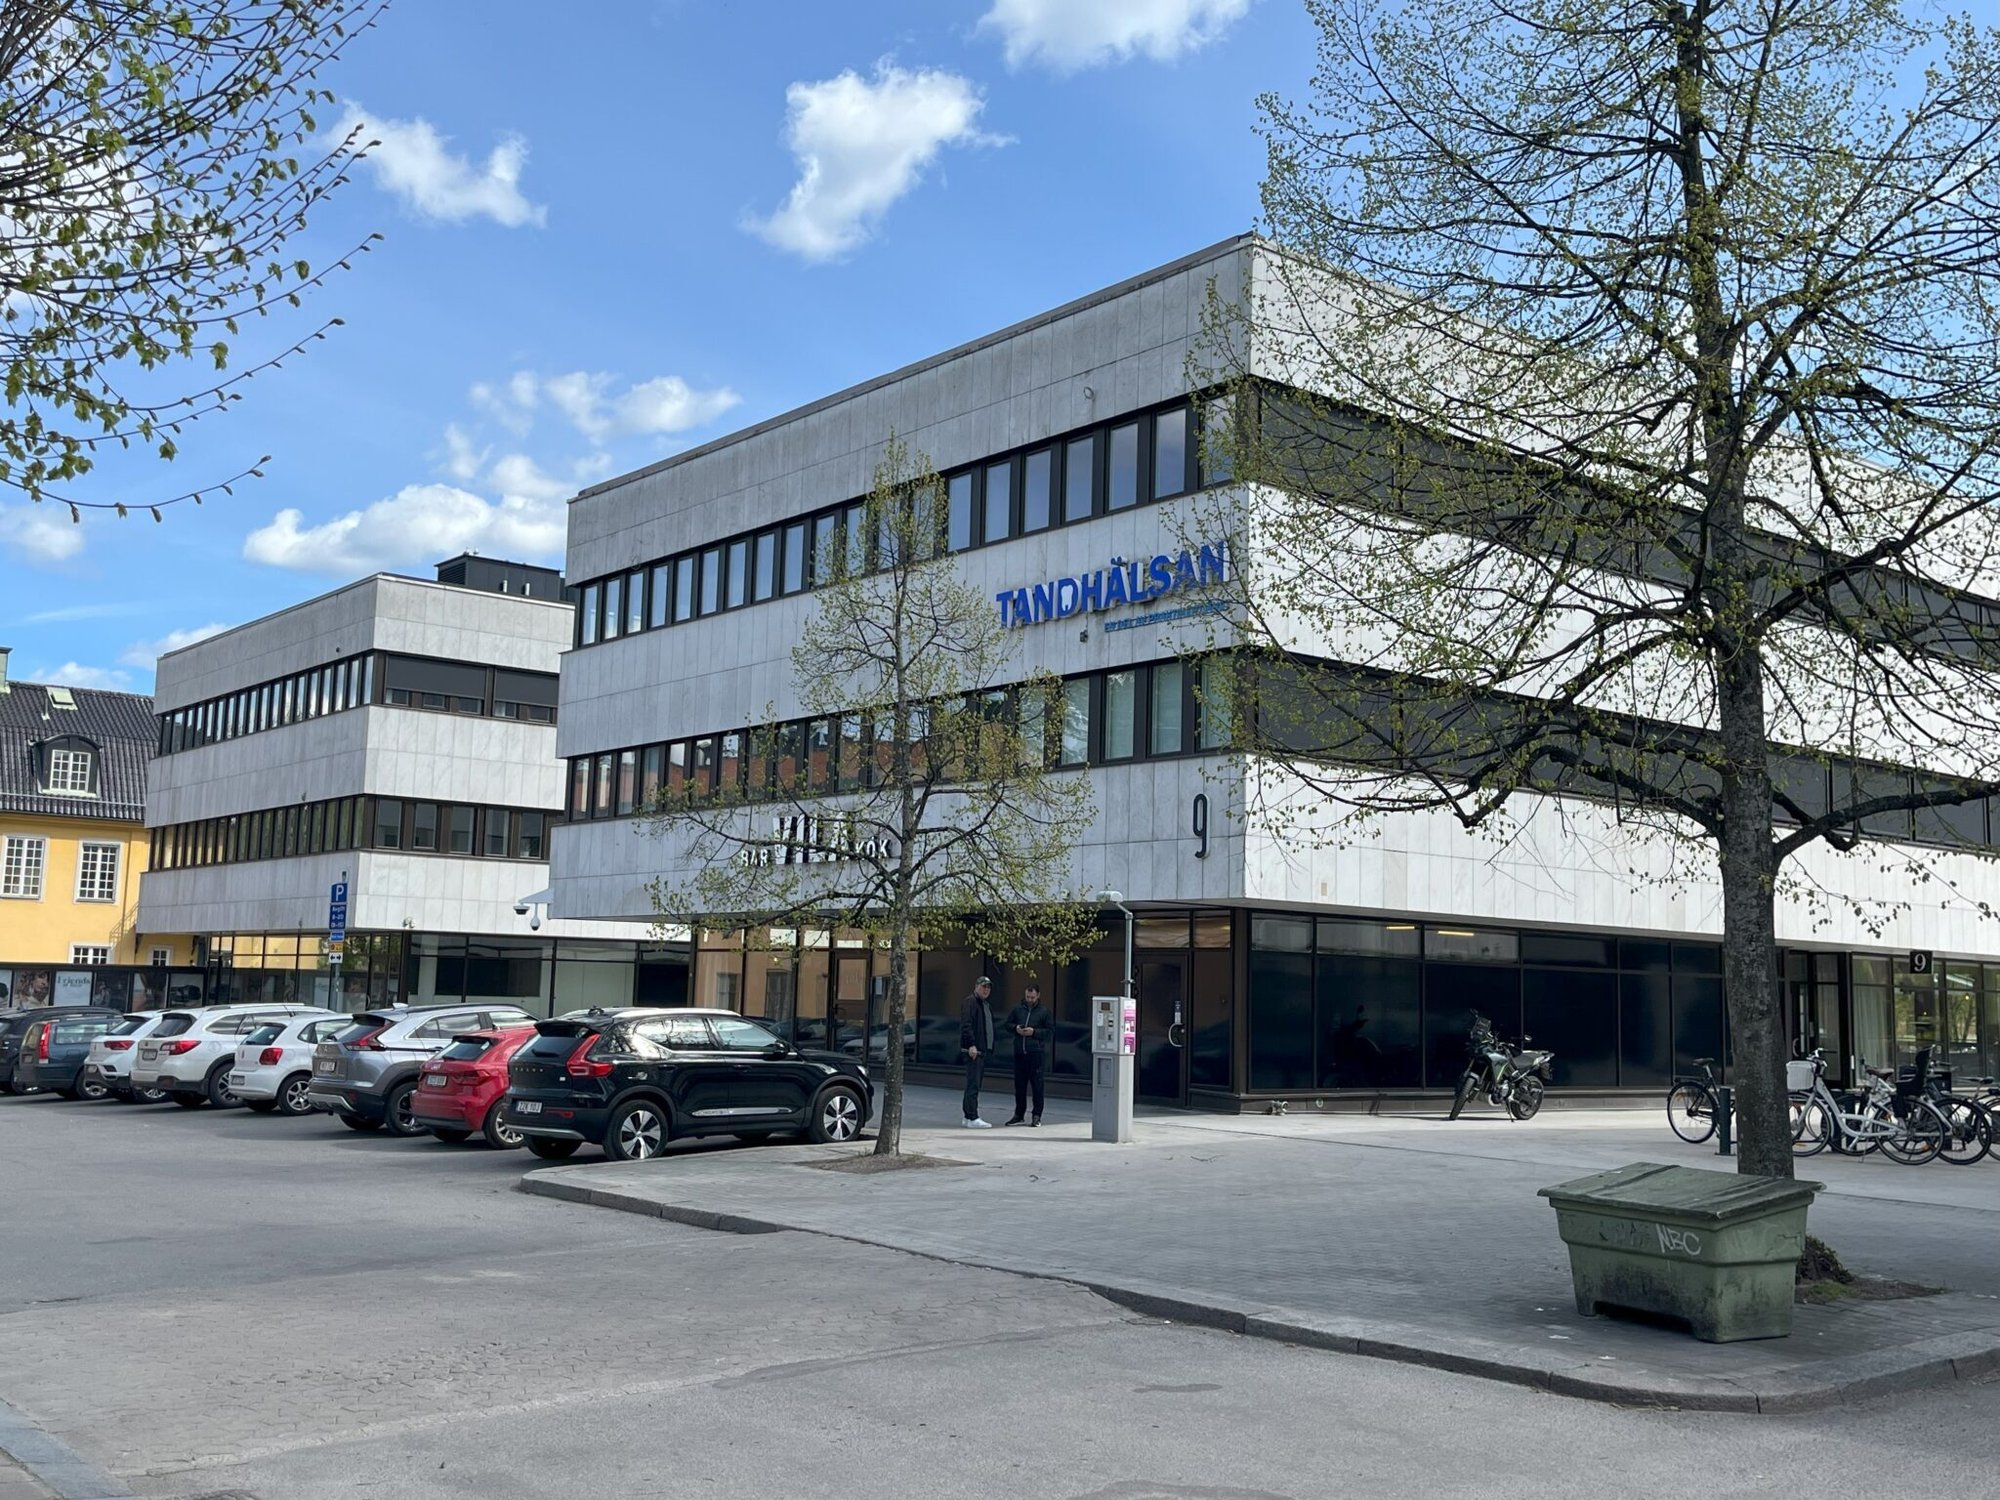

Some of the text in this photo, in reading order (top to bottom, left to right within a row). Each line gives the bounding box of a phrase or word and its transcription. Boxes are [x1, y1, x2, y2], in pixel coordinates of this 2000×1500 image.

[996, 540, 1229, 628] TANDHÄLSAN
[1193, 793, 1209, 859] 9
[335, 884, 345, 902] P
[1914, 953, 1926, 972] 9
